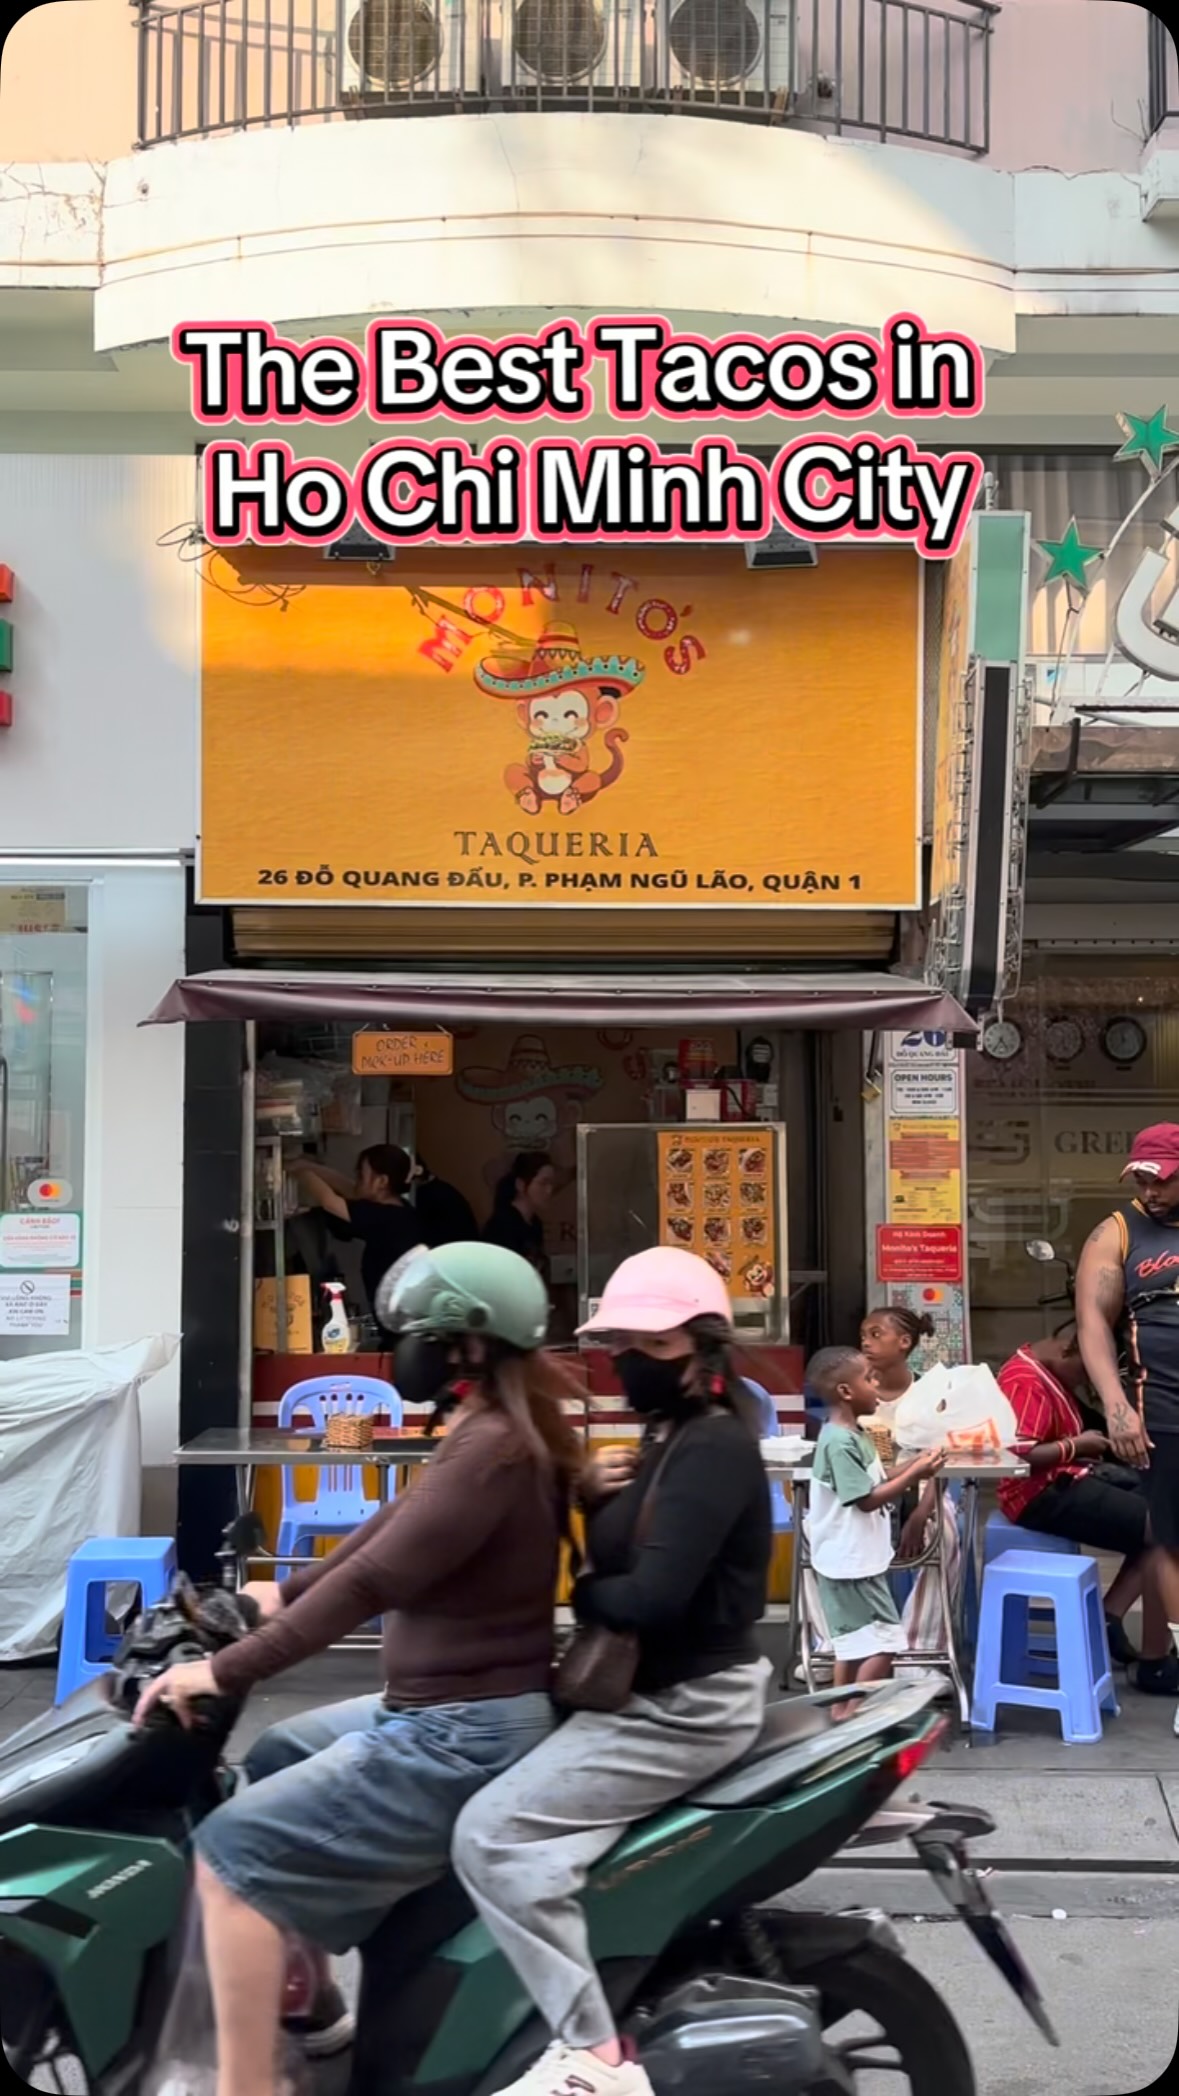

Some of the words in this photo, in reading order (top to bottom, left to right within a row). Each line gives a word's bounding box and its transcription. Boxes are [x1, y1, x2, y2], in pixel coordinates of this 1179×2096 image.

[418, 563, 706, 675] MONITO'S
[453, 831, 659, 865] TAQUERIA
[257, 869, 288, 886] 26
[295, 863, 335, 887] ĐỖ
[341, 870, 440, 889] QUANG
[518, 872, 538, 888] P.
[545, 872, 622, 892] PHẠM
[630, 868, 688, 890] NGŨ
[697, 868, 754, 892] LÃO,
[762, 870, 840, 894] QUẬN
[848, 874, 862, 890] 1
[375, 1036, 417, 1053] ORDER
[414, 1050, 445, 1065] HERE
[893, 1073, 919, 1082] OPEN
[920, 1073, 953, 1082] HOURS
